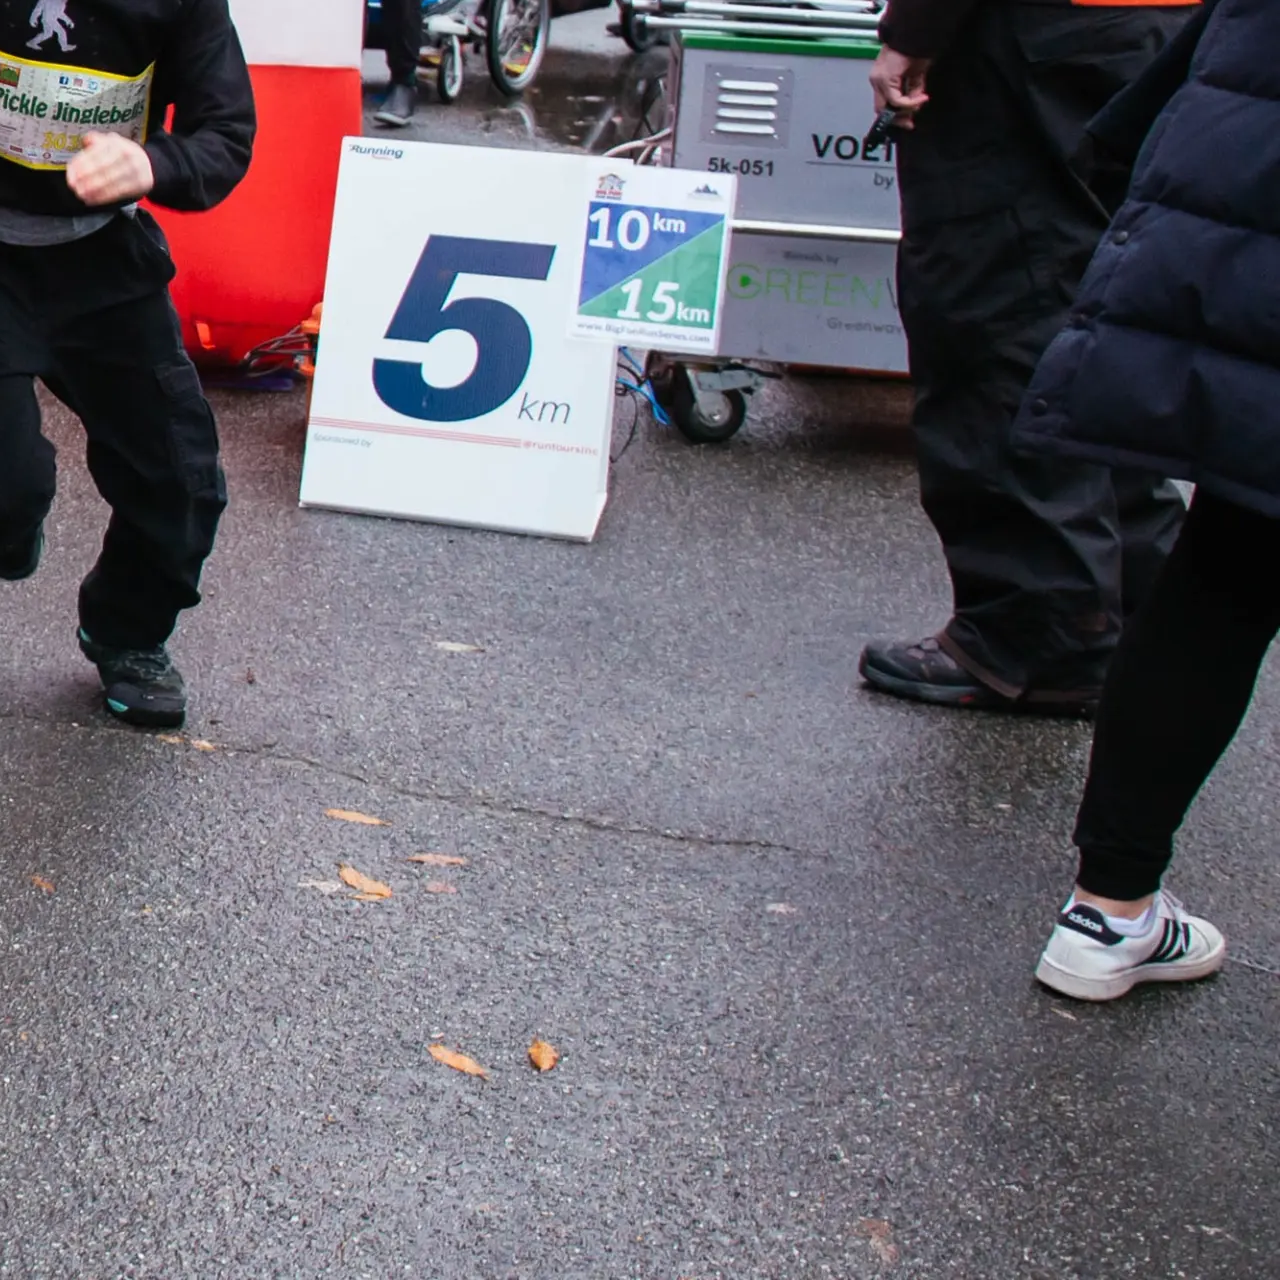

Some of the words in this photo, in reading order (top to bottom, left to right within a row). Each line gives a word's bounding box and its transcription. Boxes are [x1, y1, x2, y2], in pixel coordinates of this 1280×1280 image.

[52, 99, 144, 125] Jinglebells
[348, 144, 404, 159] Running
[707, 157, 775, 177] 5k-051
[873, 172, 895, 190] by
[588, 206, 651, 251] 10
[652, 211, 687, 234] km
[726, 262, 897, 310] GREEN
[371, 233, 557, 423] 5
[517, 391, 572, 425] km
[1067, 911, 1103, 934] adidas
